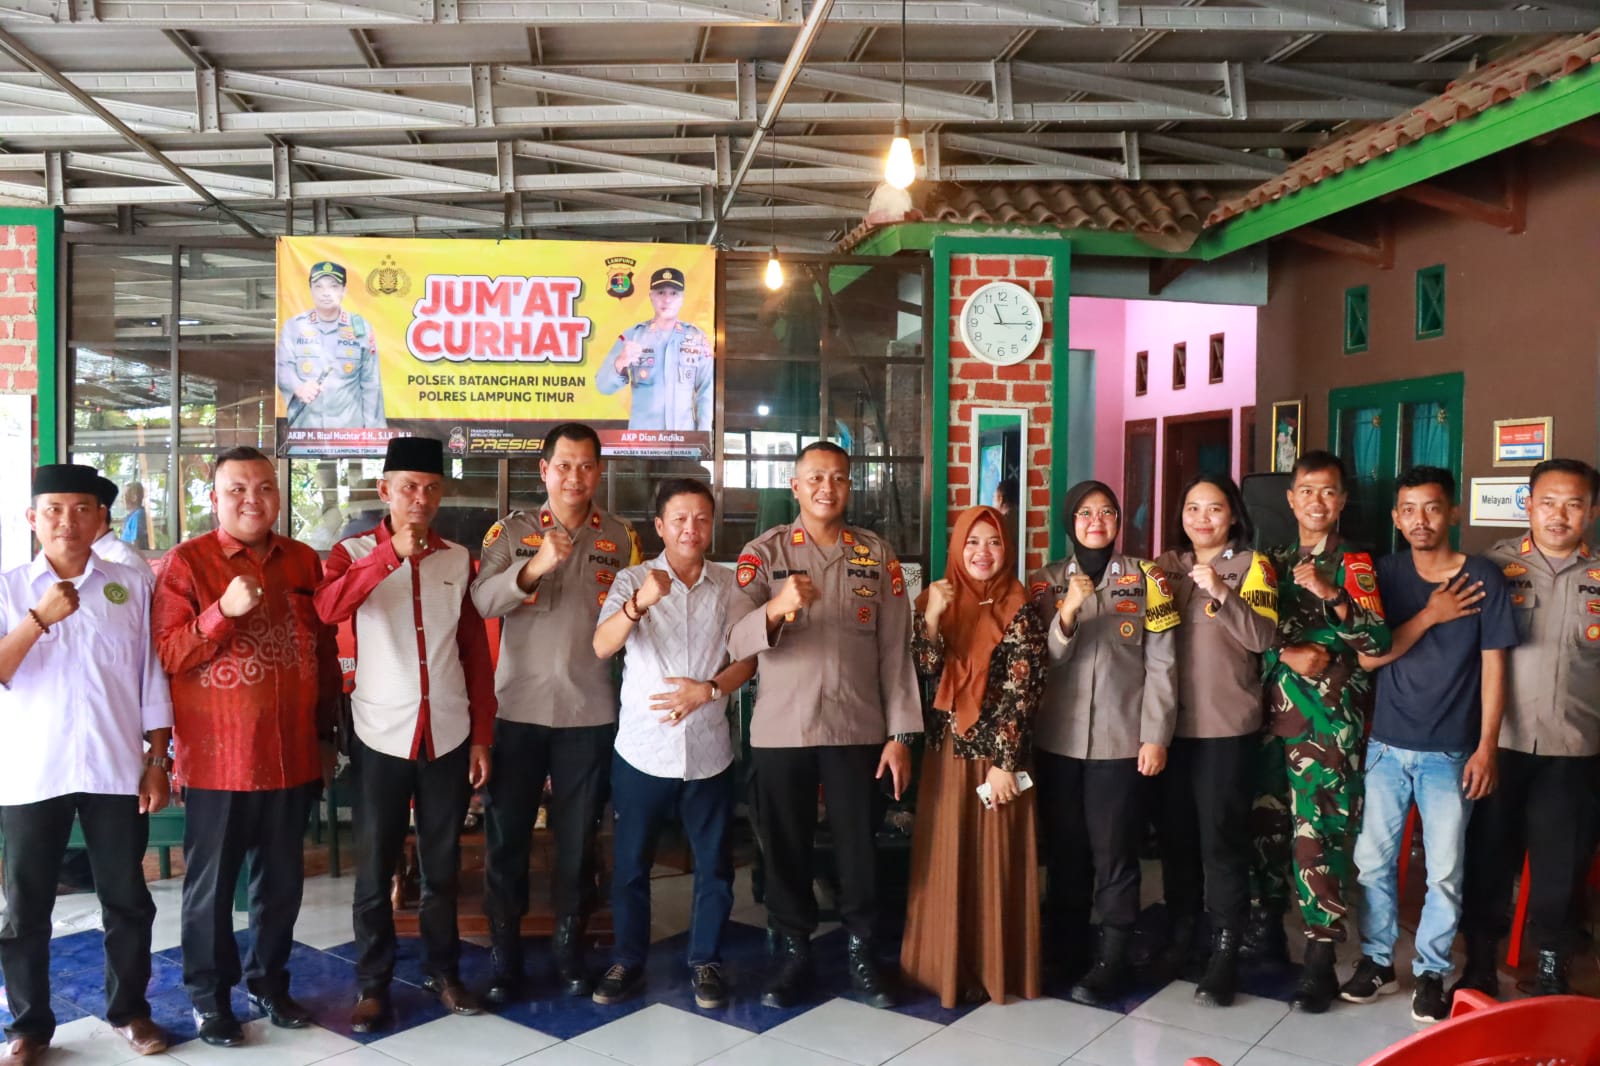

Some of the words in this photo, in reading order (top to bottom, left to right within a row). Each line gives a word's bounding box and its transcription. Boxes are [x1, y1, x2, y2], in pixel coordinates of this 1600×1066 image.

[419, 280, 577, 317] JUM'AT
[985, 294, 992, 303] 11
[998, 291, 1007, 301] 12
[974, 305, 984, 314] 10
[1021, 306, 1029, 315] 2
[970, 318, 978, 327] 9
[412, 320, 586, 357] CURHAT
[974, 331, 982, 341] 8
[1021, 334, 1028, 343] 4
[985, 343, 992, 352] 7
[997, 346, 1005, 356] 6
[1011, 344, 1018, 353] 5
[407, 375, 456, 385] POLSEK
[459, 375, 539, 387] BATANGHARI
[542, 376, 586, 387] NUBAN
[418, 391, 467, 402] POLRES
[470, 391, 532, 402] LAMPUNG
[536, 392, 575, 403] TIMUR
[287, 431, 306, 440] AKBP
[317, 431, 333, 440] Rizal
[334, 431, 360, 440] Muchtar
[621, 433, 638, 442] AKP
[639, 433, 657, 442] Dian
[658, 433, 685, 442] Andika
[470, 438, 545, 450] PRESISI
[1481, 495, 1512, 507] Melayani
[588, 554, 621, 568] POLRI
[847, 568, 880, 580] POLRI
[1111, 587, 1144, 598] POLRI
